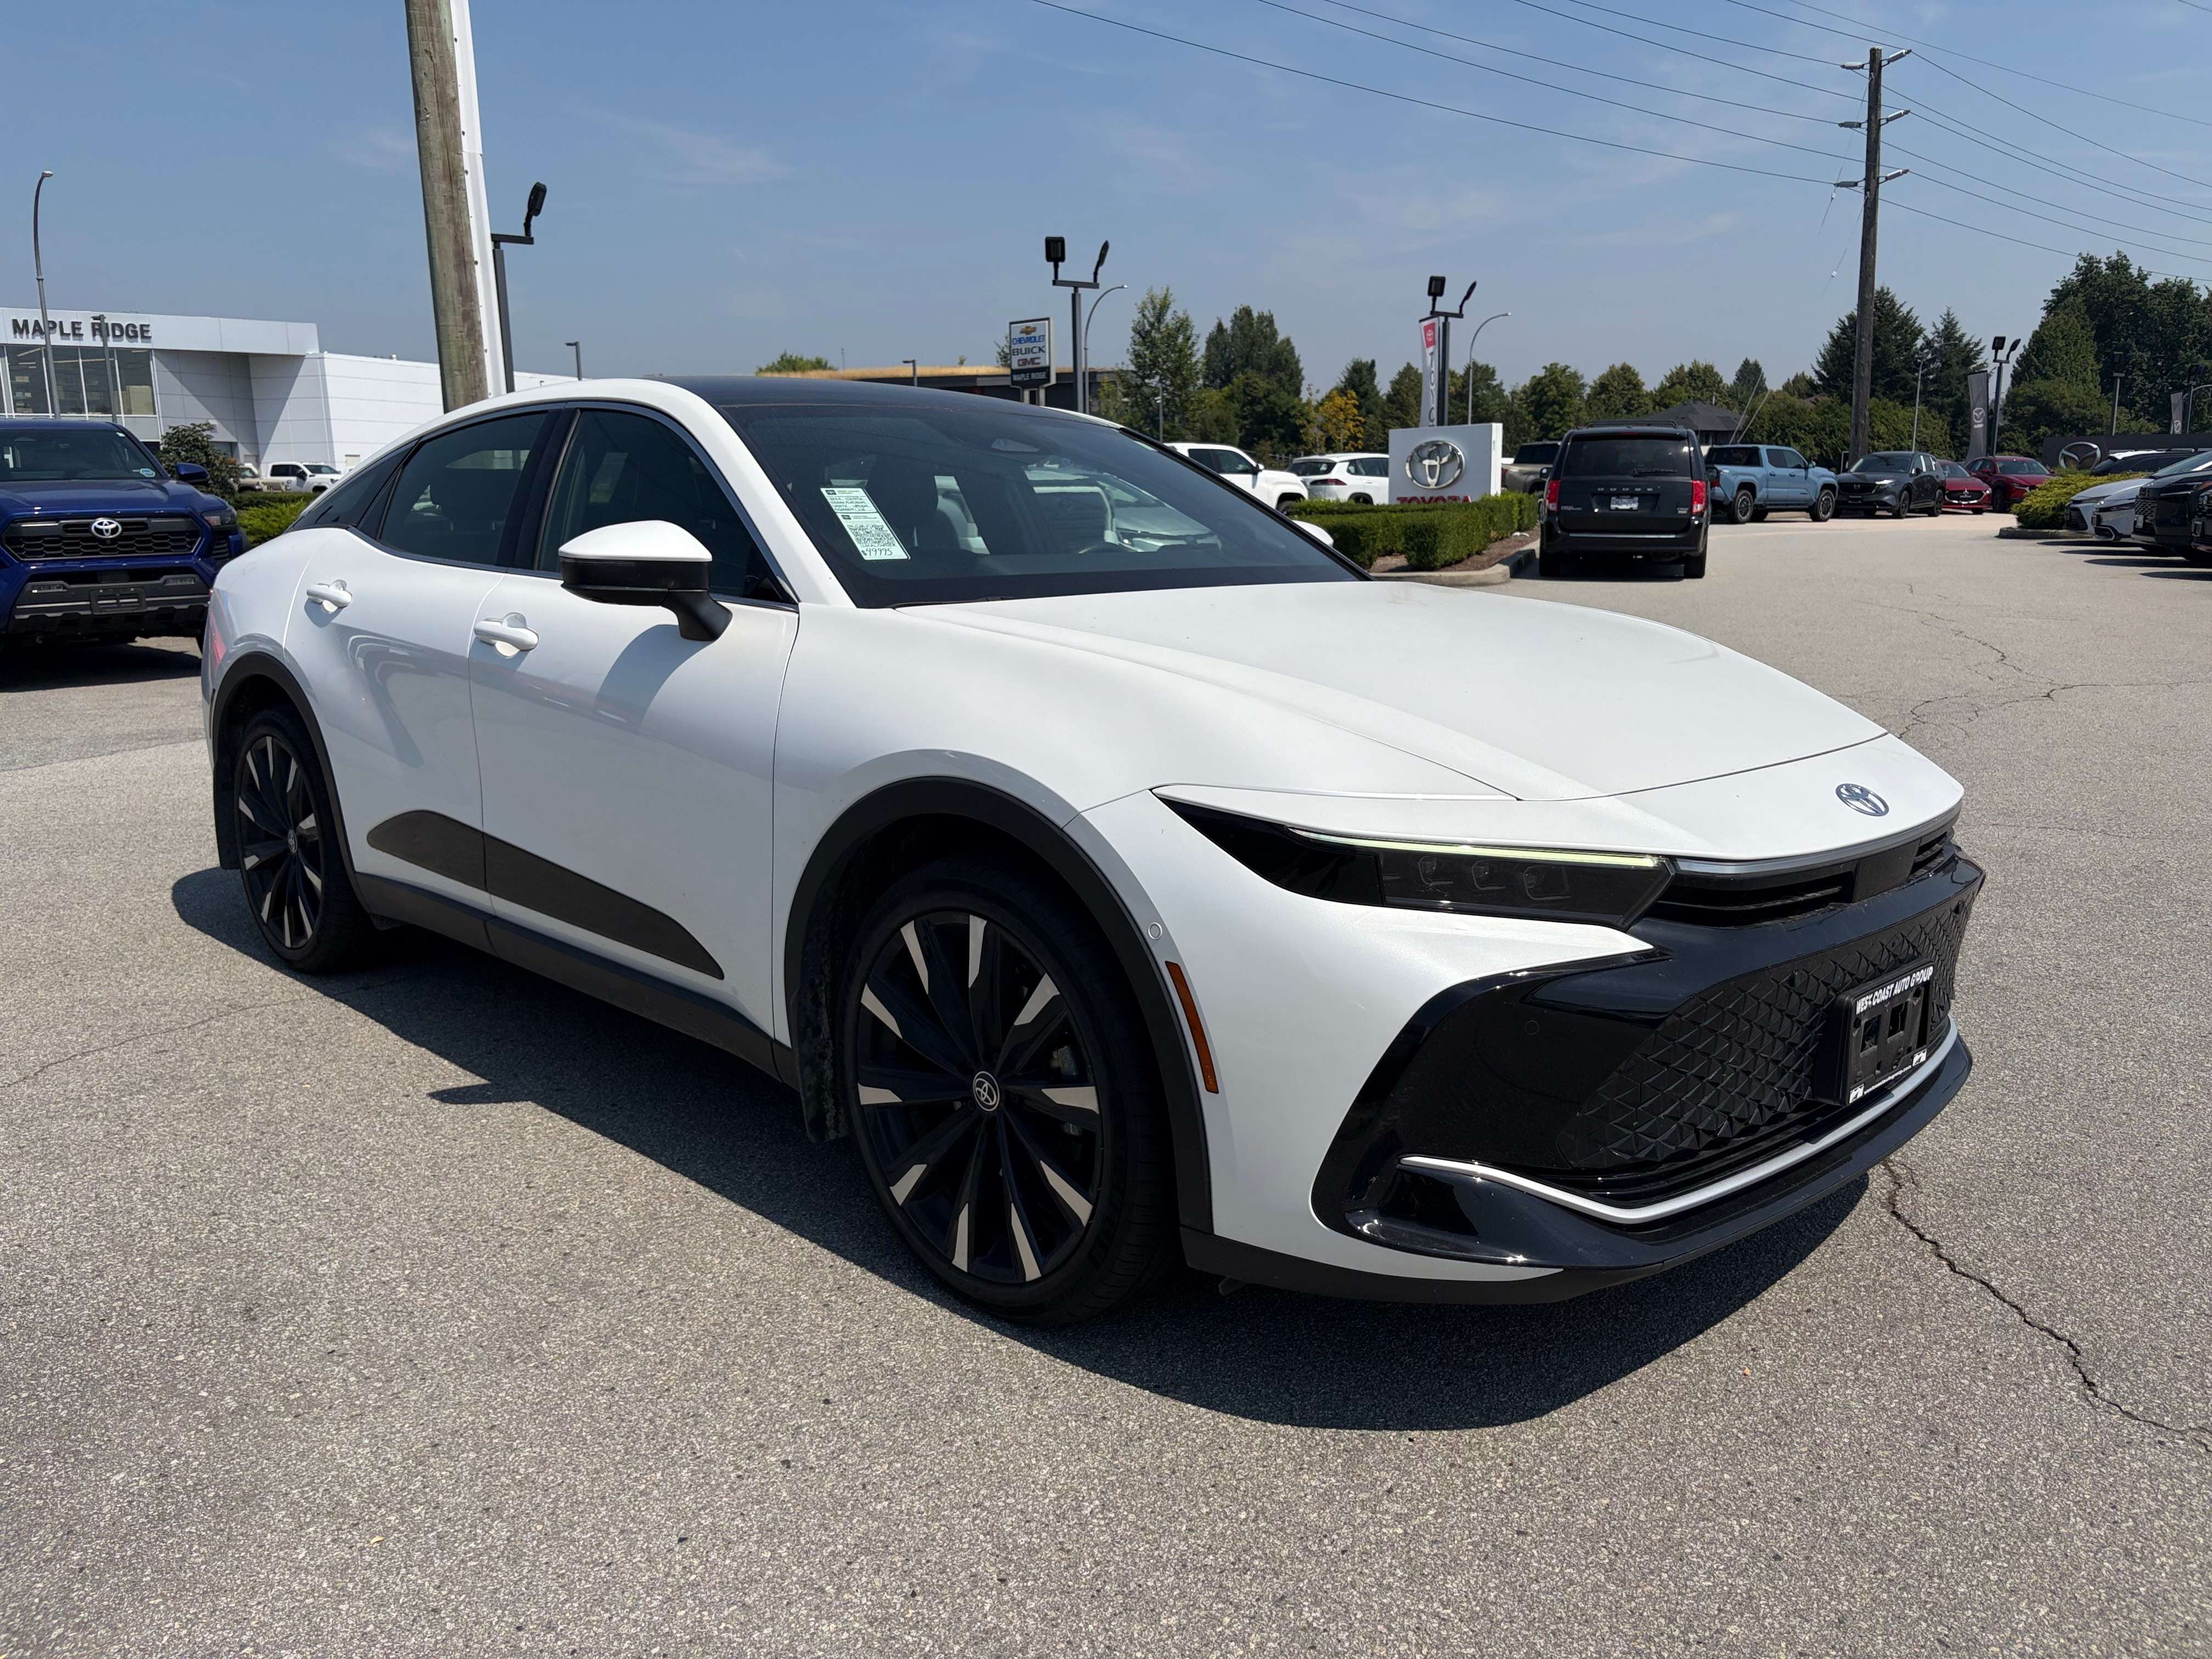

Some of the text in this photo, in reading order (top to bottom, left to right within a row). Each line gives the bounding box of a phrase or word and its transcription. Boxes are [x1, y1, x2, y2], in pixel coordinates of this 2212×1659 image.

[12, 319, 152, 338] MAPLE RIDGE
[1012, 335, 1046, 345] CHEVROLET
[1012, 346, 1046, 356] BUICK
[1017, 357, 1041, 367] GMC
[861, 548, 893, 556] $49995
[1856, 966, 1933, 1015] WEST COAST AUTO GROUP
